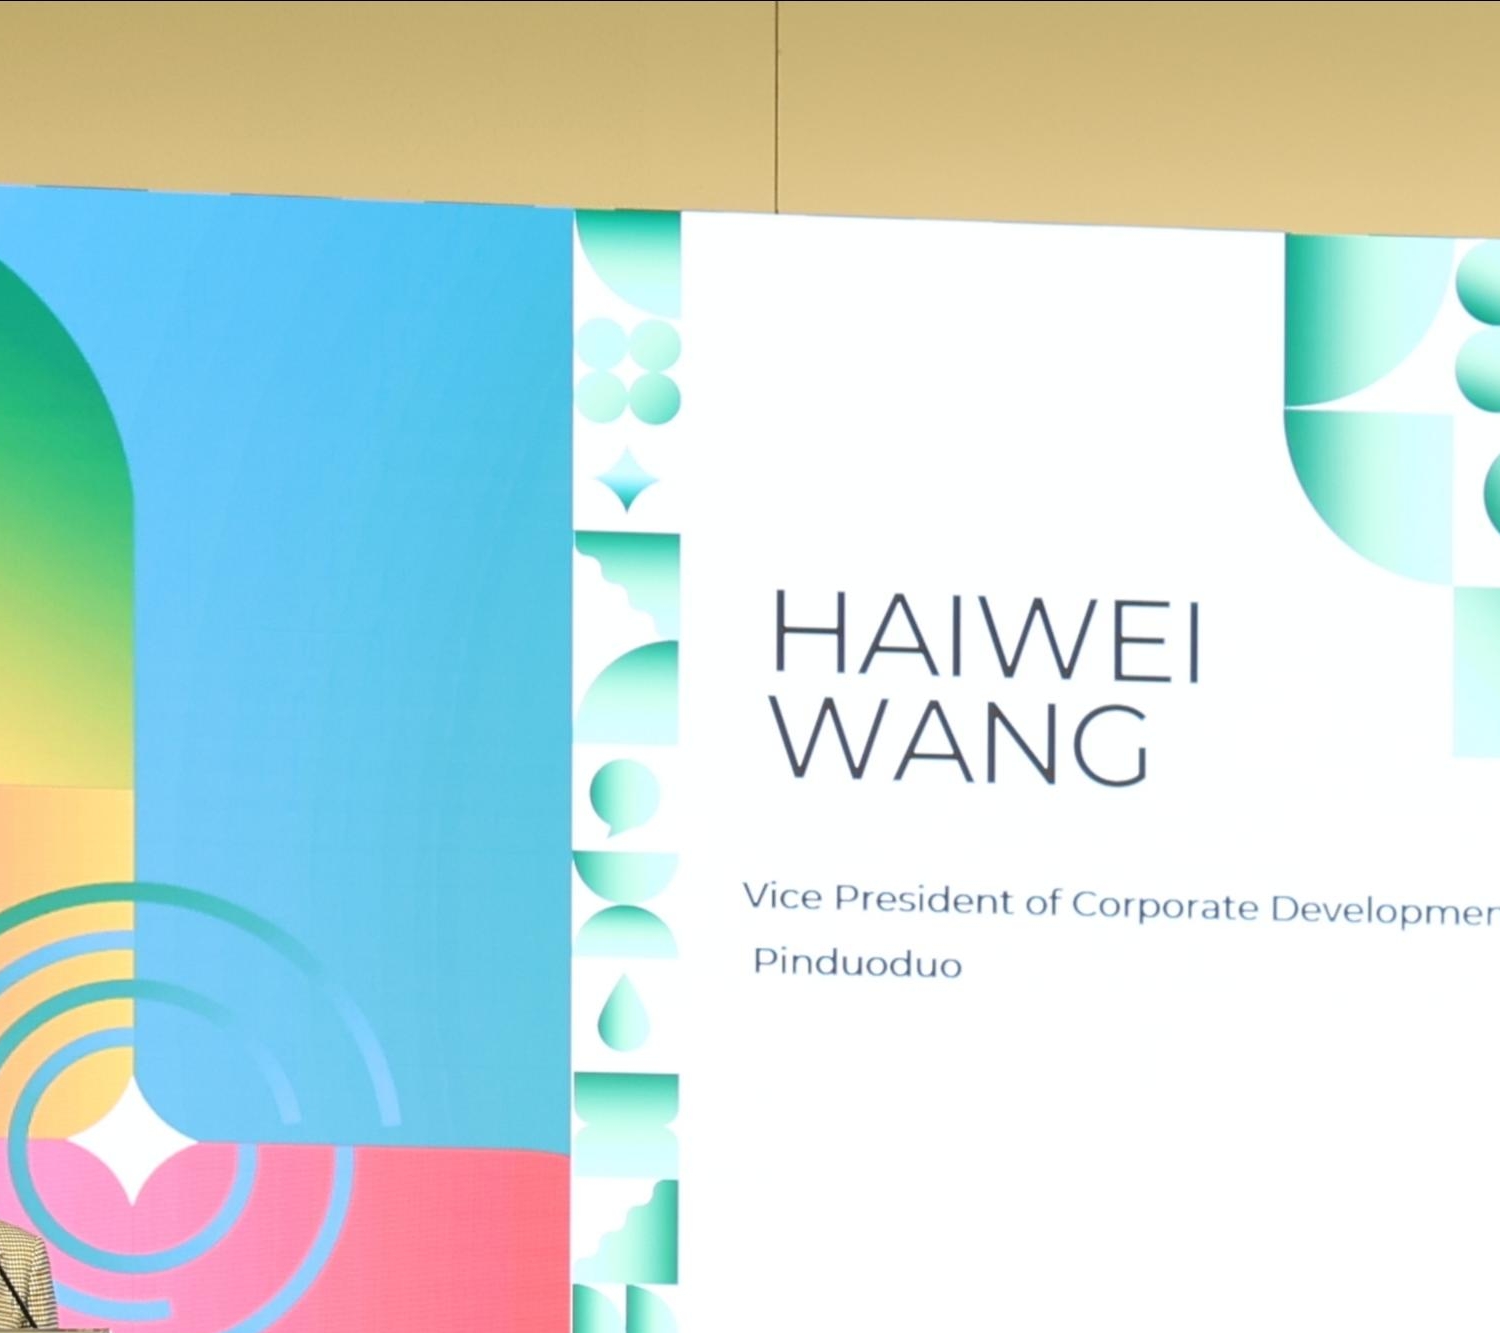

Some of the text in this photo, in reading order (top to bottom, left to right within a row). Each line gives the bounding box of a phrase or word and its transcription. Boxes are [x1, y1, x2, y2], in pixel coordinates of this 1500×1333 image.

[773, 588, 1202, 685] HAIWEI
[767, 693, 1150, 789] WANG
[742, 880, 823, 911] Vice
[833, 882, 1015, 917] President
[1025, 886, 1064, 917] of
[1071, 890, 1260, 927] Corporate
[753, 946, 964, 980] Pinduoduo
